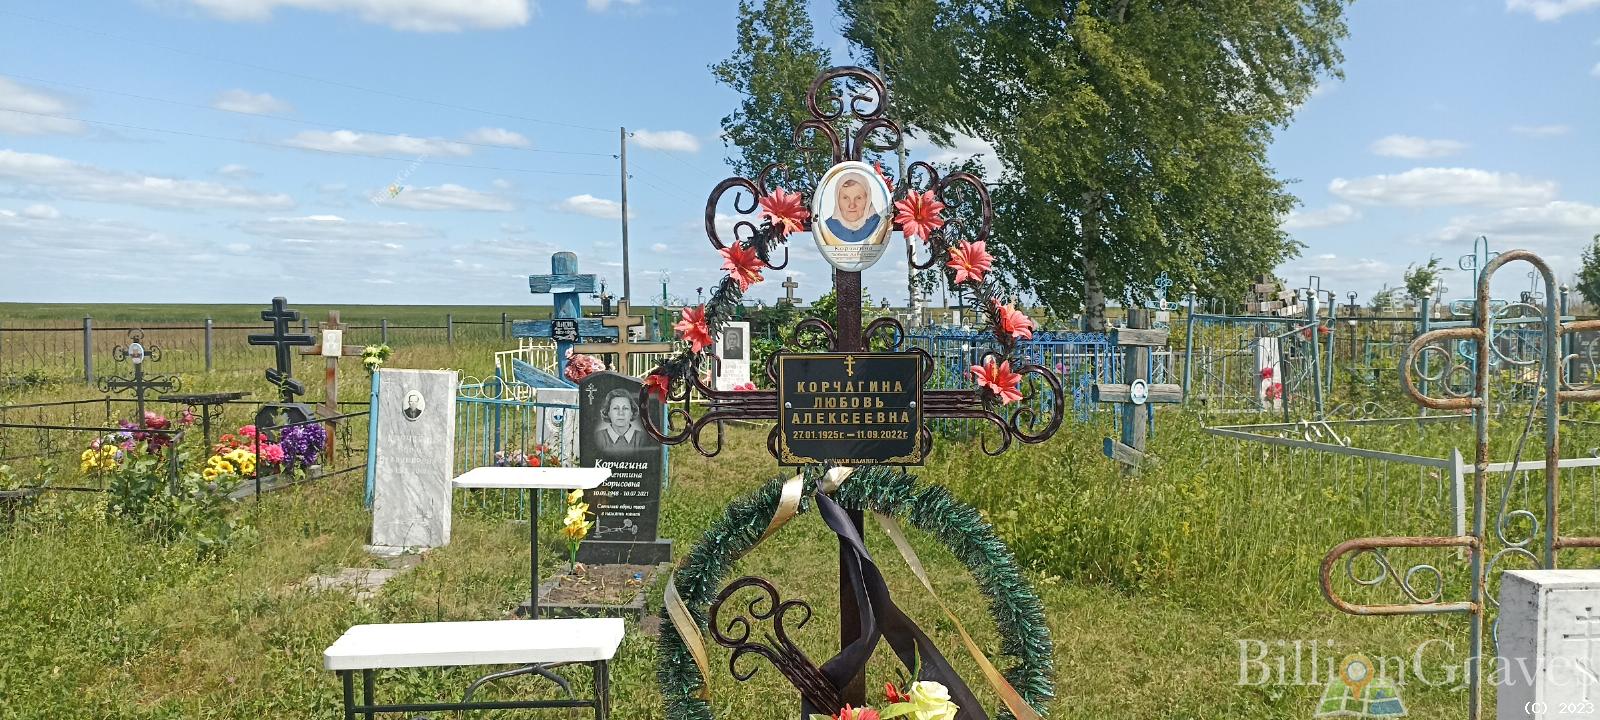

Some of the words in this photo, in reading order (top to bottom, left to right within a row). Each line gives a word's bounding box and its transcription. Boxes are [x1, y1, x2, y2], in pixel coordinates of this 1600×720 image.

[797, 381, 903, 393] КОРЧАГИНА
[813, 397, 884, 408] ЛЮБОВЬ
[791, 411, 910, 424] АЛЕКСЕЕВНА
[594, 458, 648, 470] Корчагина
